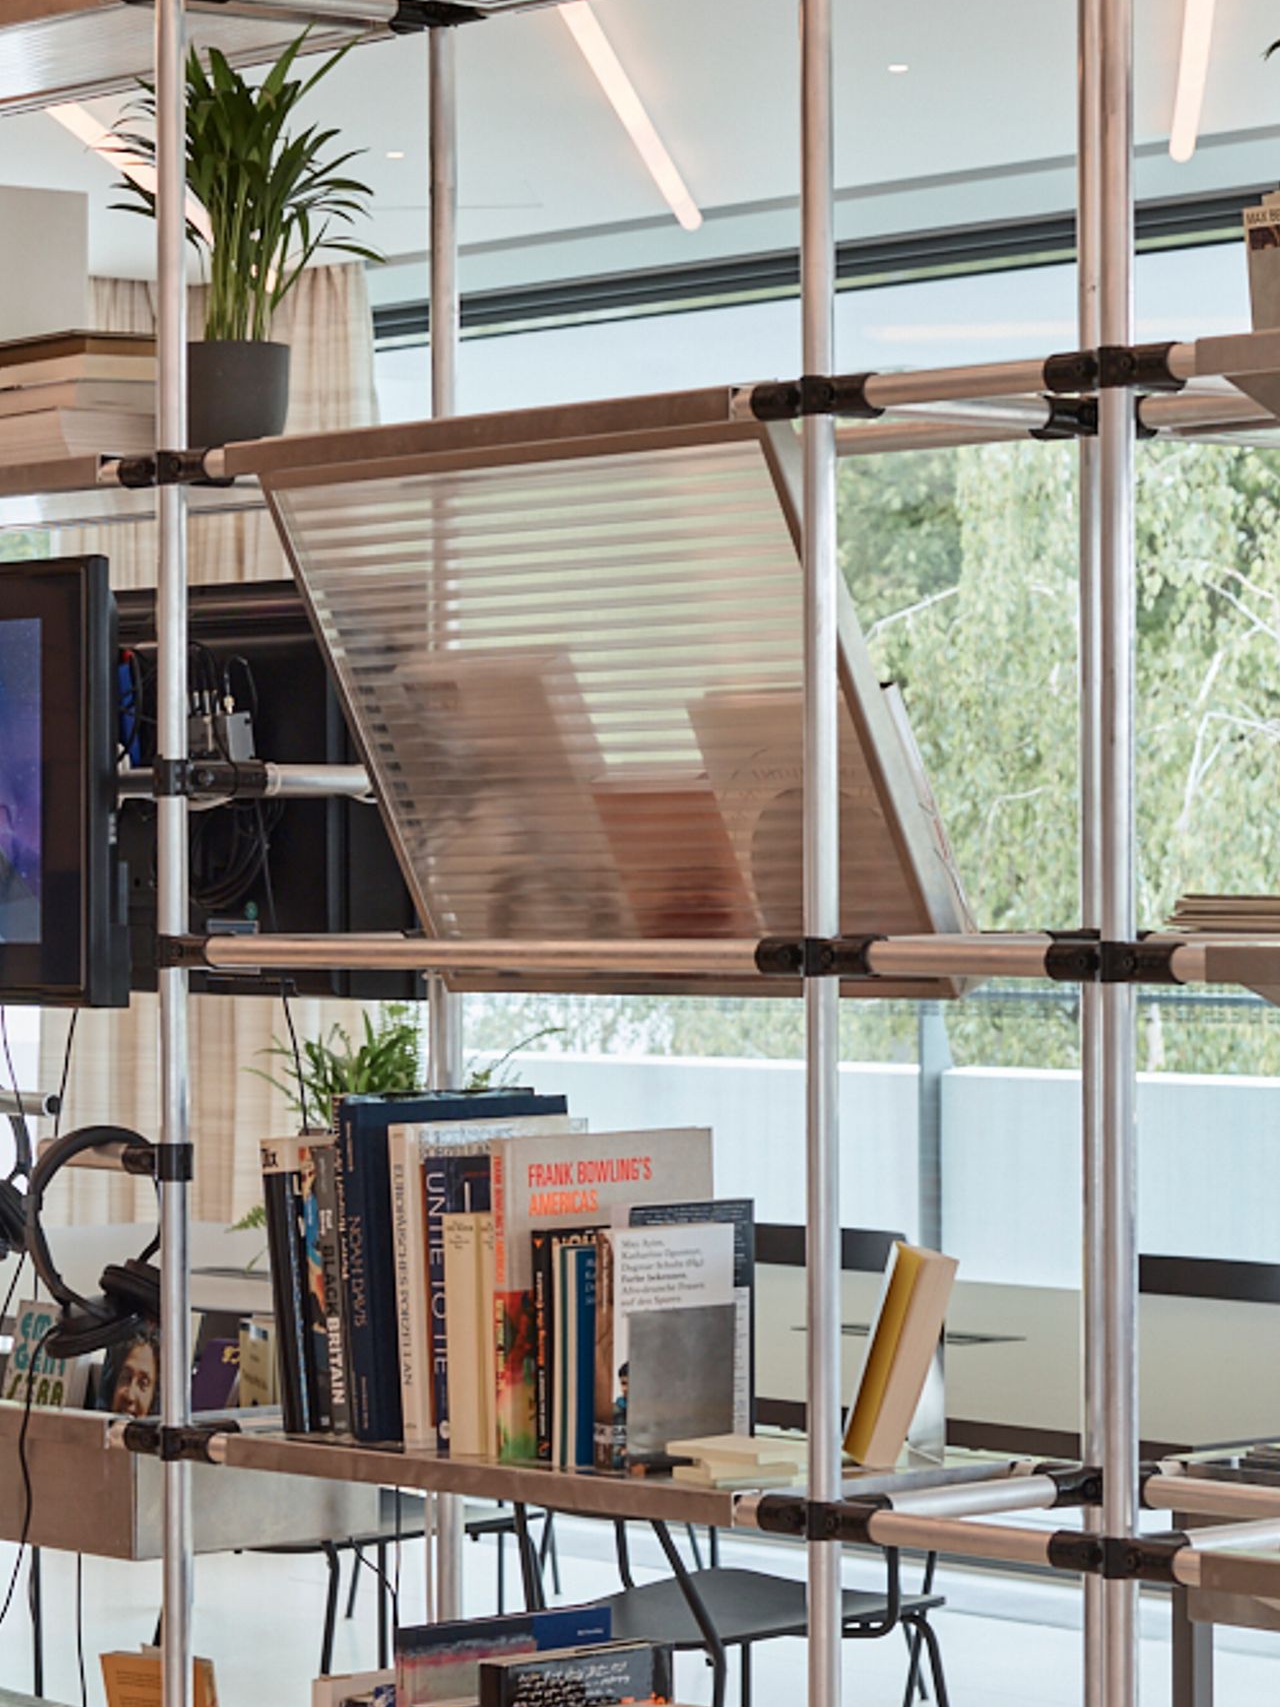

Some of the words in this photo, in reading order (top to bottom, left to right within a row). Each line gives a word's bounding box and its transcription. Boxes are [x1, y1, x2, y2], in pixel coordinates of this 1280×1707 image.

[527, 1162, 574, 1188] FRANK
[576, 1155, 653, 1185] BOWLING'S
[527, 1188, 599, 1217] AMERICAS
